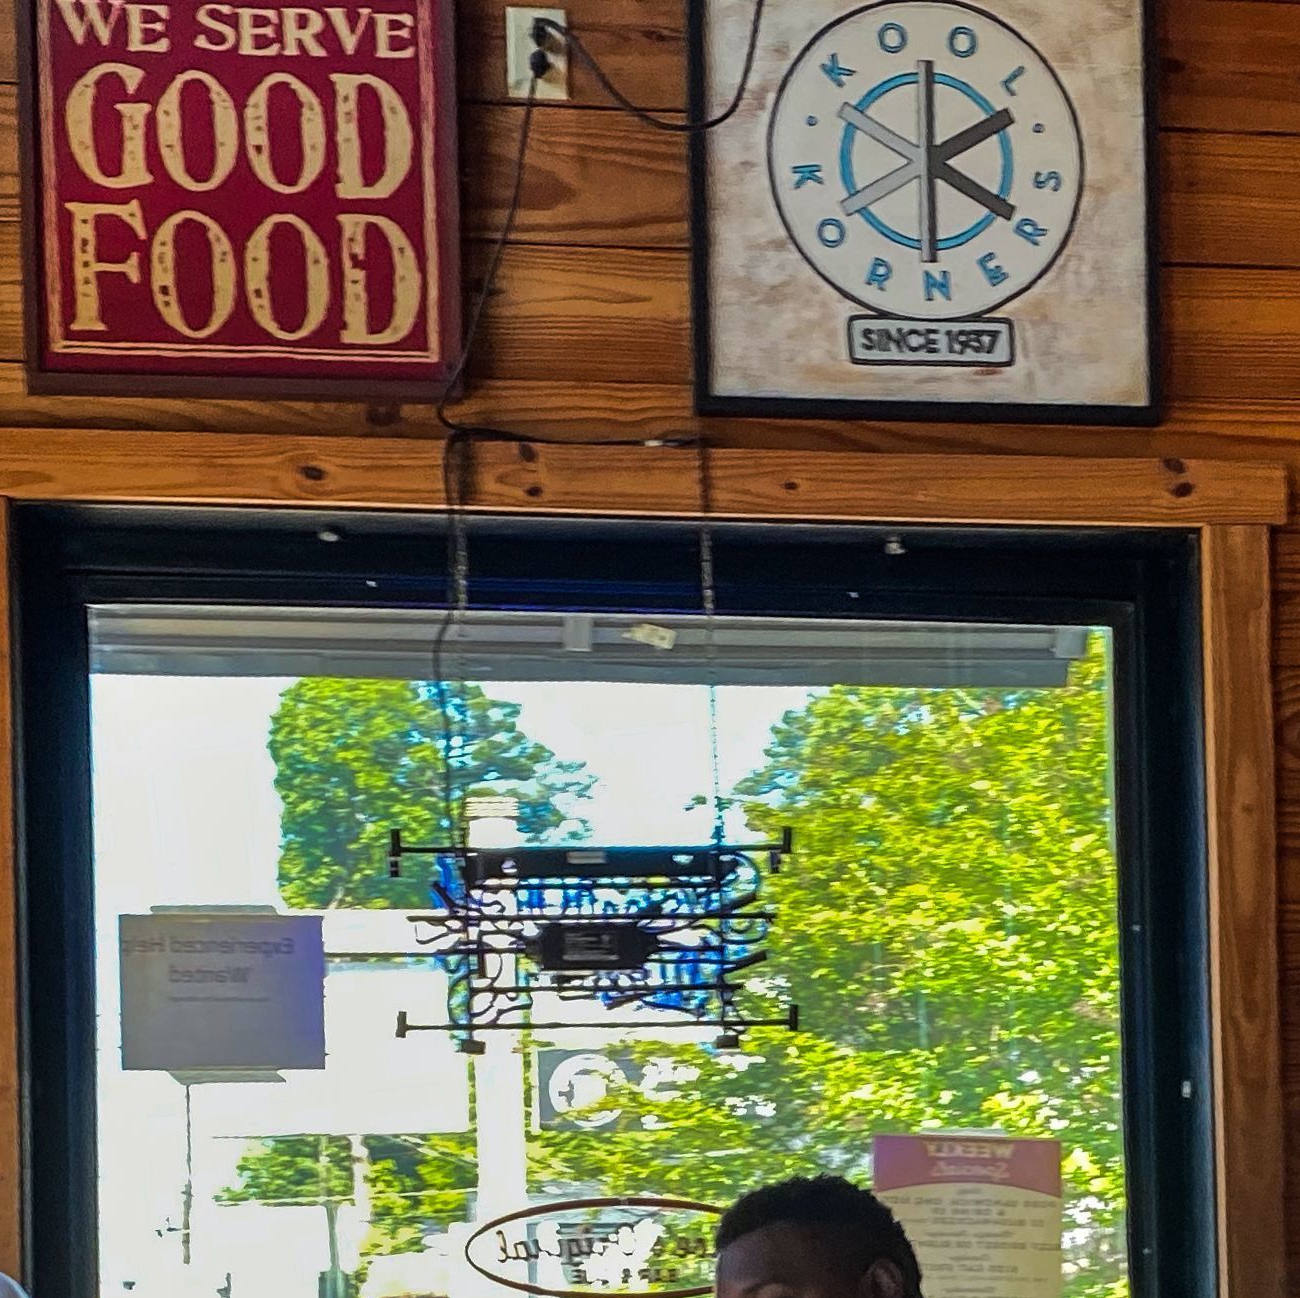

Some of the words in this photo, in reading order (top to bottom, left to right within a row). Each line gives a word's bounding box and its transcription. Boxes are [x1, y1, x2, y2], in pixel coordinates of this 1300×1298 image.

[52, 0, 170, 53] WE
[194, 3, 415, 58] SERVE
[819, 22, 1027, 97] KOOL
[64, 61, 414, 199] GOOD
[64, 199, 422, 345] FOOD
[791, 164, 1062, 302] KORNERS
[861, 327, 941, 354] SINCE
